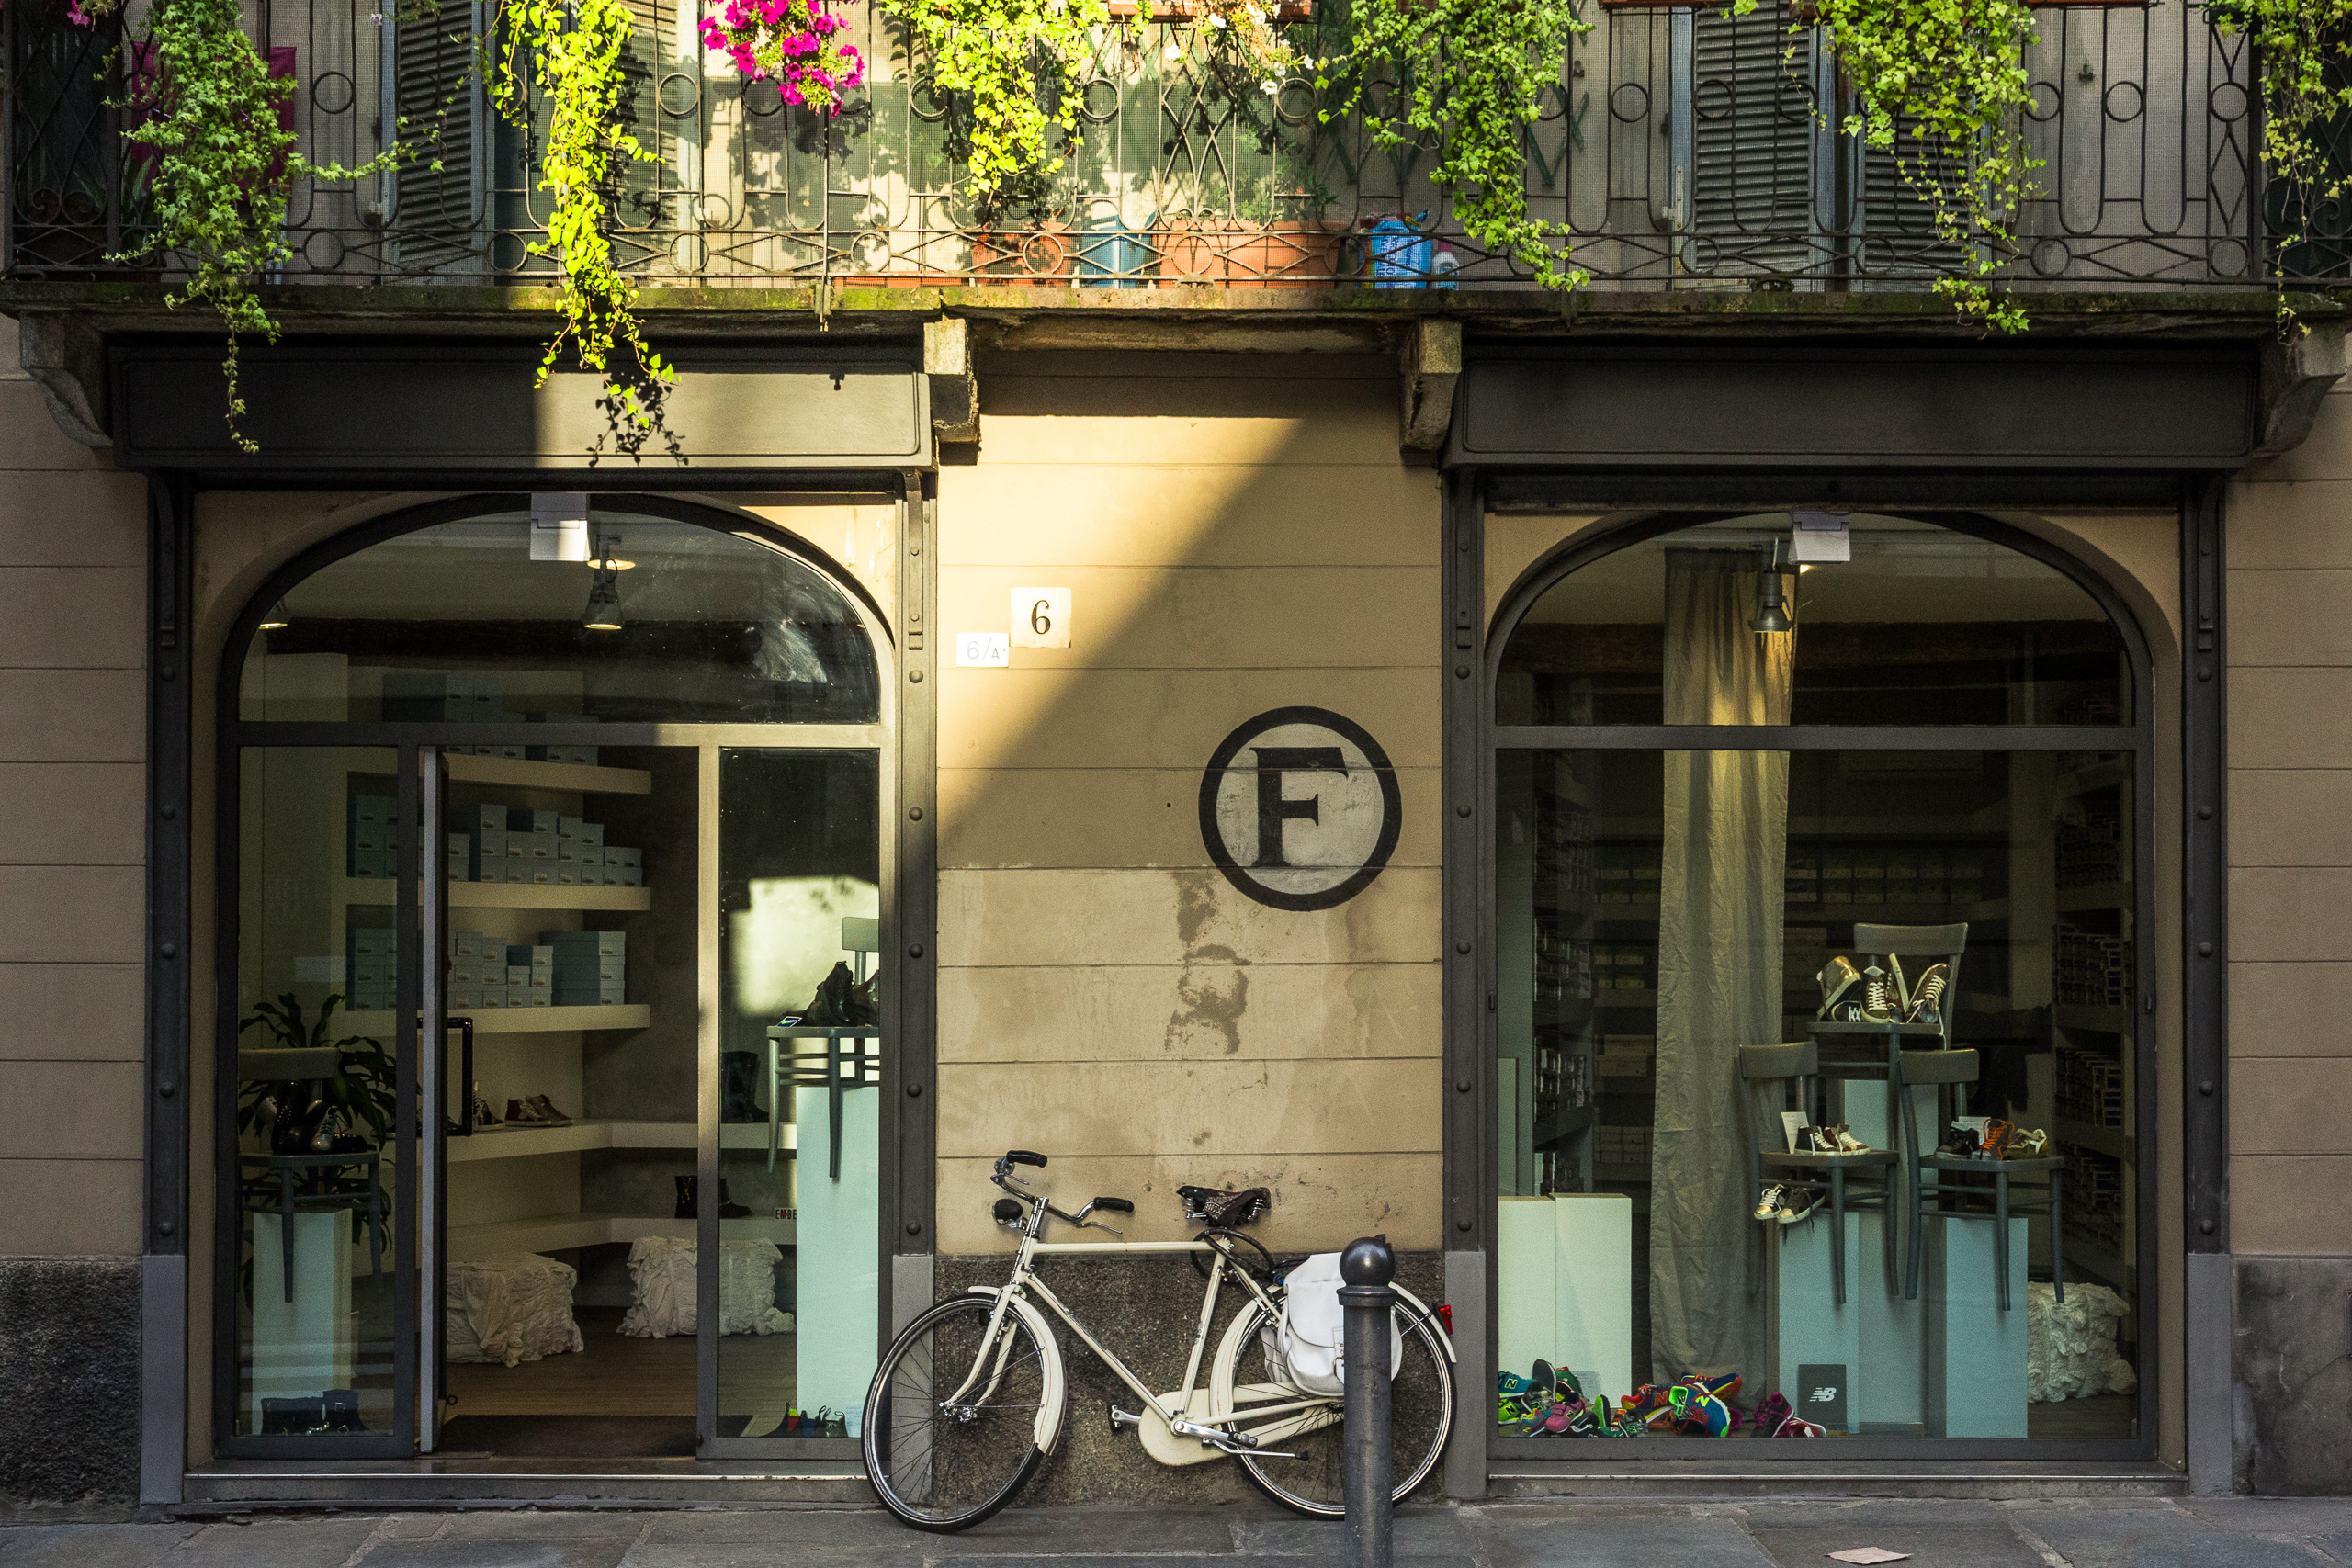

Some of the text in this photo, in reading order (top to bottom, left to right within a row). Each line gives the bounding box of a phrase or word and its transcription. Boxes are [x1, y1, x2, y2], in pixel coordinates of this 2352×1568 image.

[1031, 599, 1051, 635] 6
[967, 637, 1000, 662] 6/A
[1249, 746, 1349, 868] F
[1505, 1379, 1518, 1389] N
[1654, 1391, 1668, 1406] N
[1695, 1395, 1710, 1407] N
[1809, 1387, 1837, 1402] NB
[1505, 1404, 1517, 1416] N
